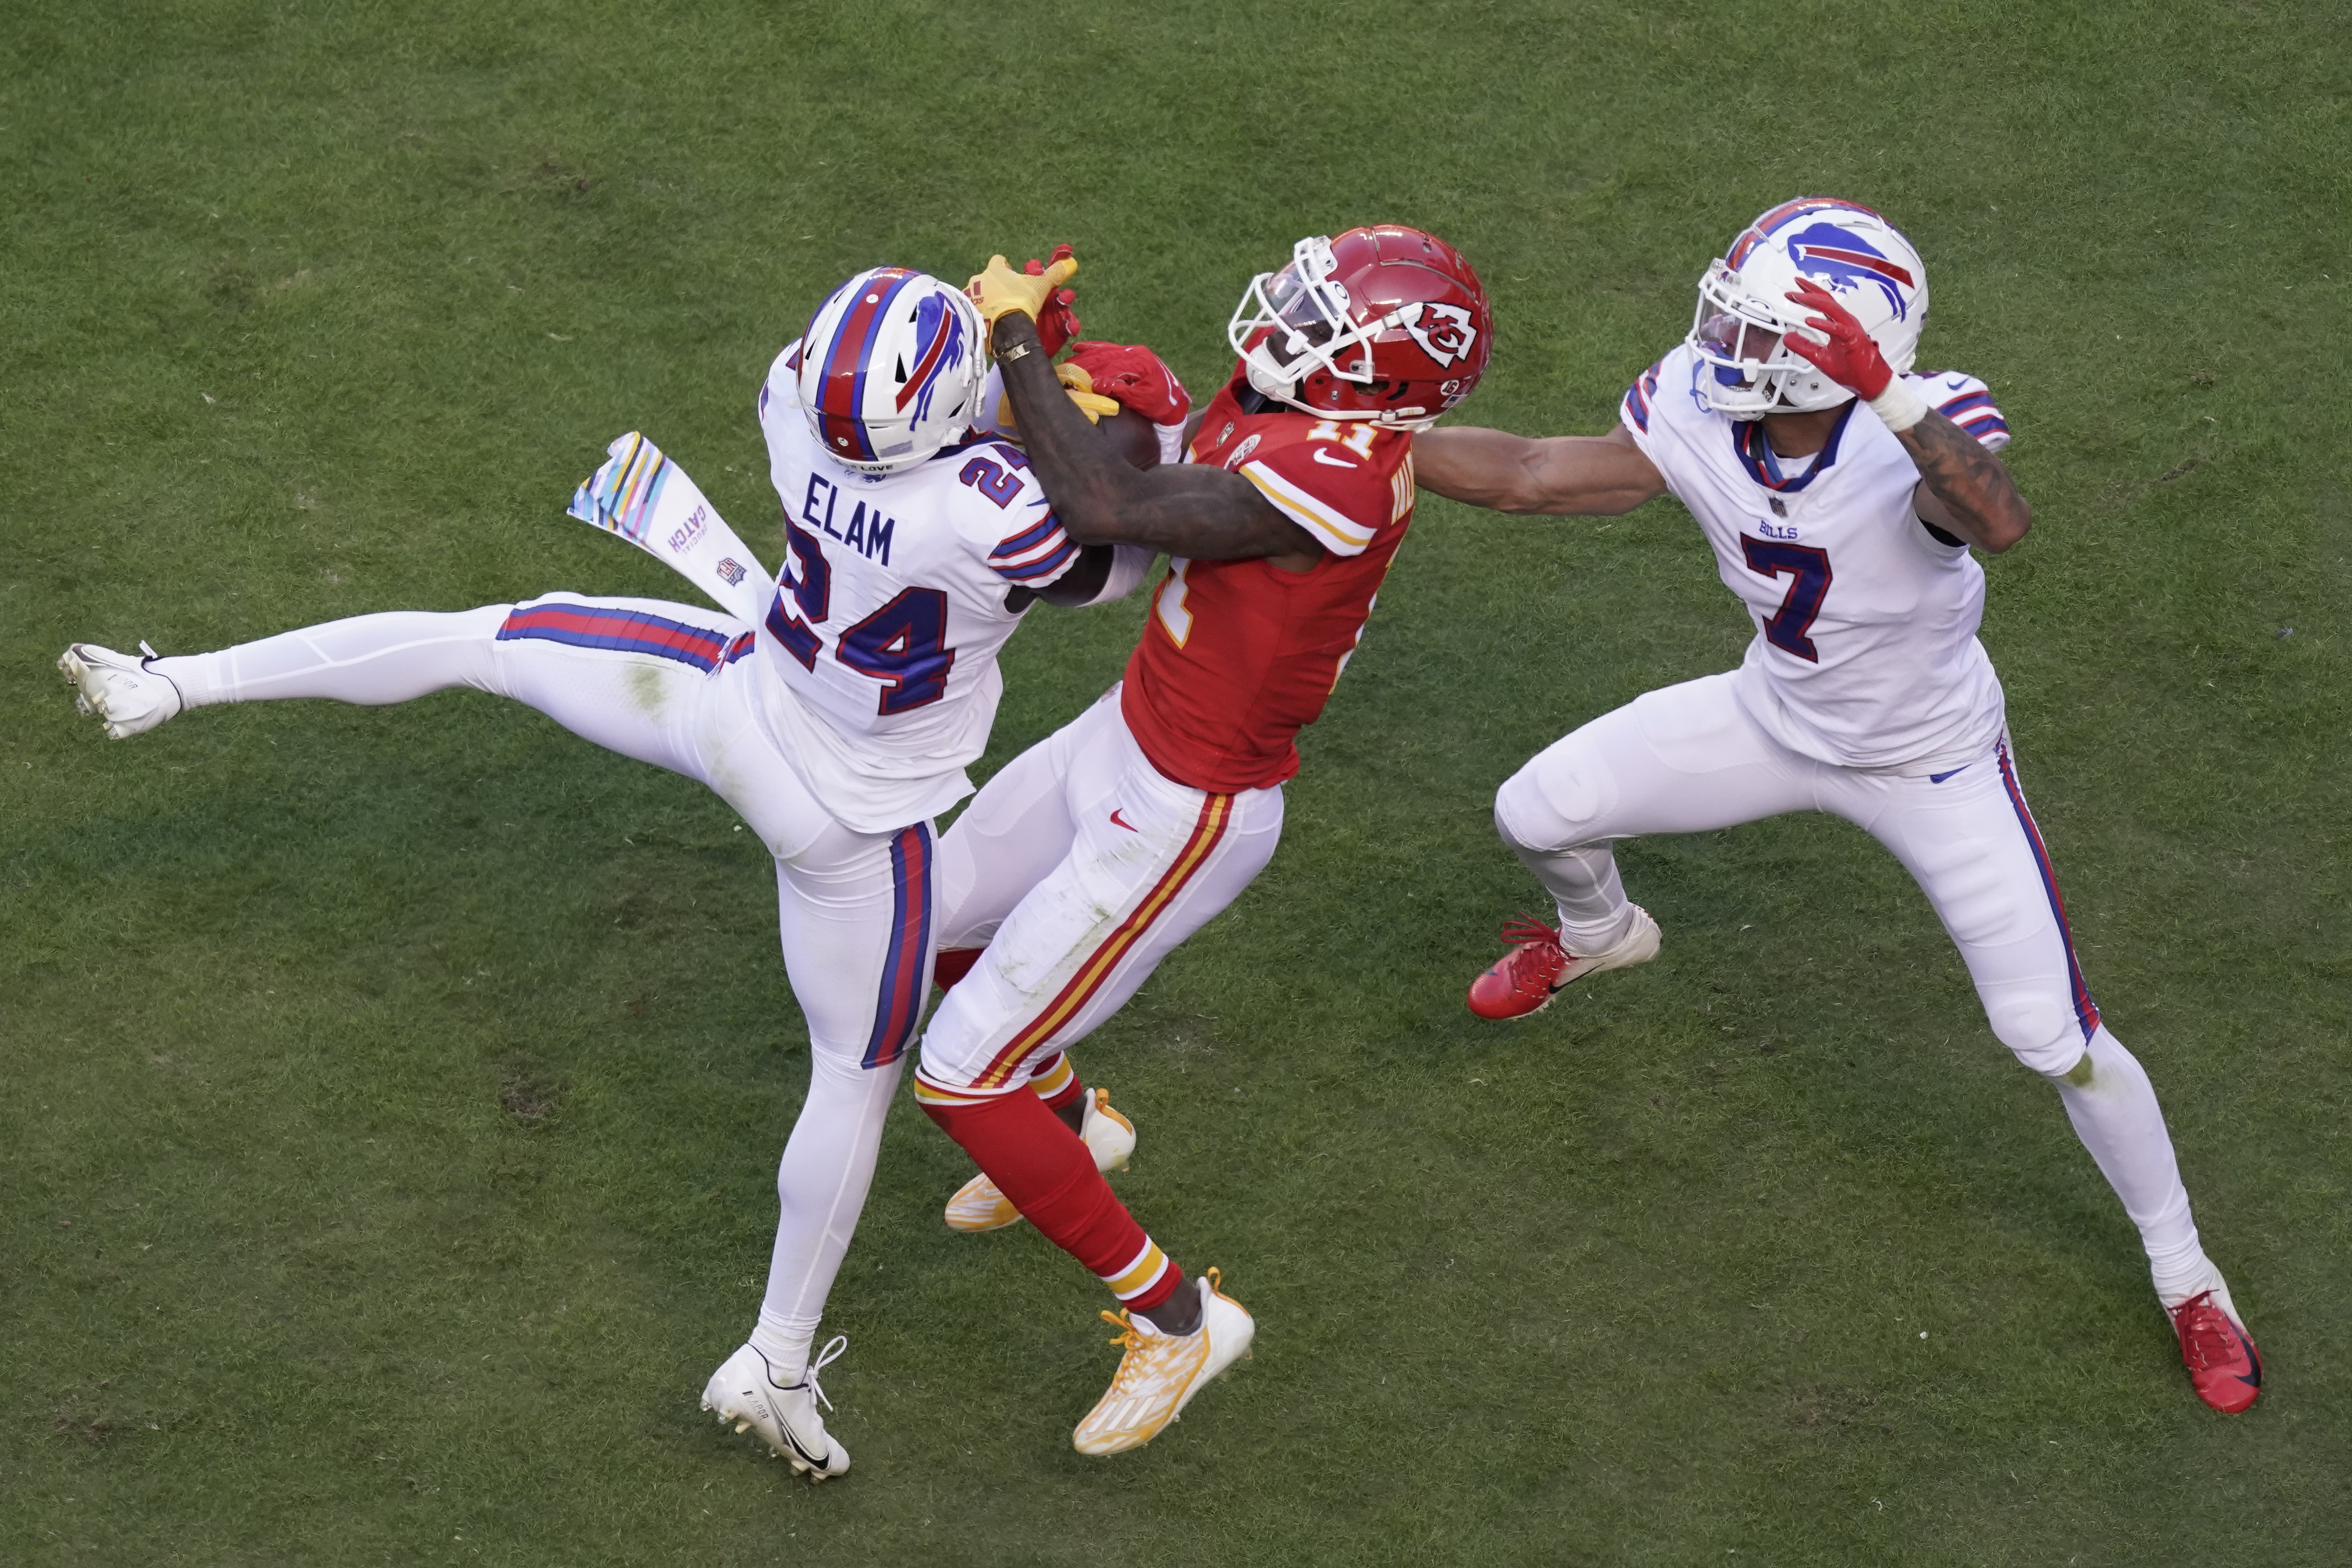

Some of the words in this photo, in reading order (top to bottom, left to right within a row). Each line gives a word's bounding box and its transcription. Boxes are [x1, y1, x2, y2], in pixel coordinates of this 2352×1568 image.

[1414, 305, 1467, 354] KC
[1307, 420, 1377, 461] 11
[959, 444, 1037, 509] 24
[668, 504, 706, 553] CATCH
[682, 523, 707, 555] CRUCIAL
[803, 472, 895, 567] ELAM
[1759, 520, 1798, 539] BILLS
[719, 559, 737, 577] NFL
[766, 507, 956, 715] 24
[1740, 531, 1833, 664] 7
